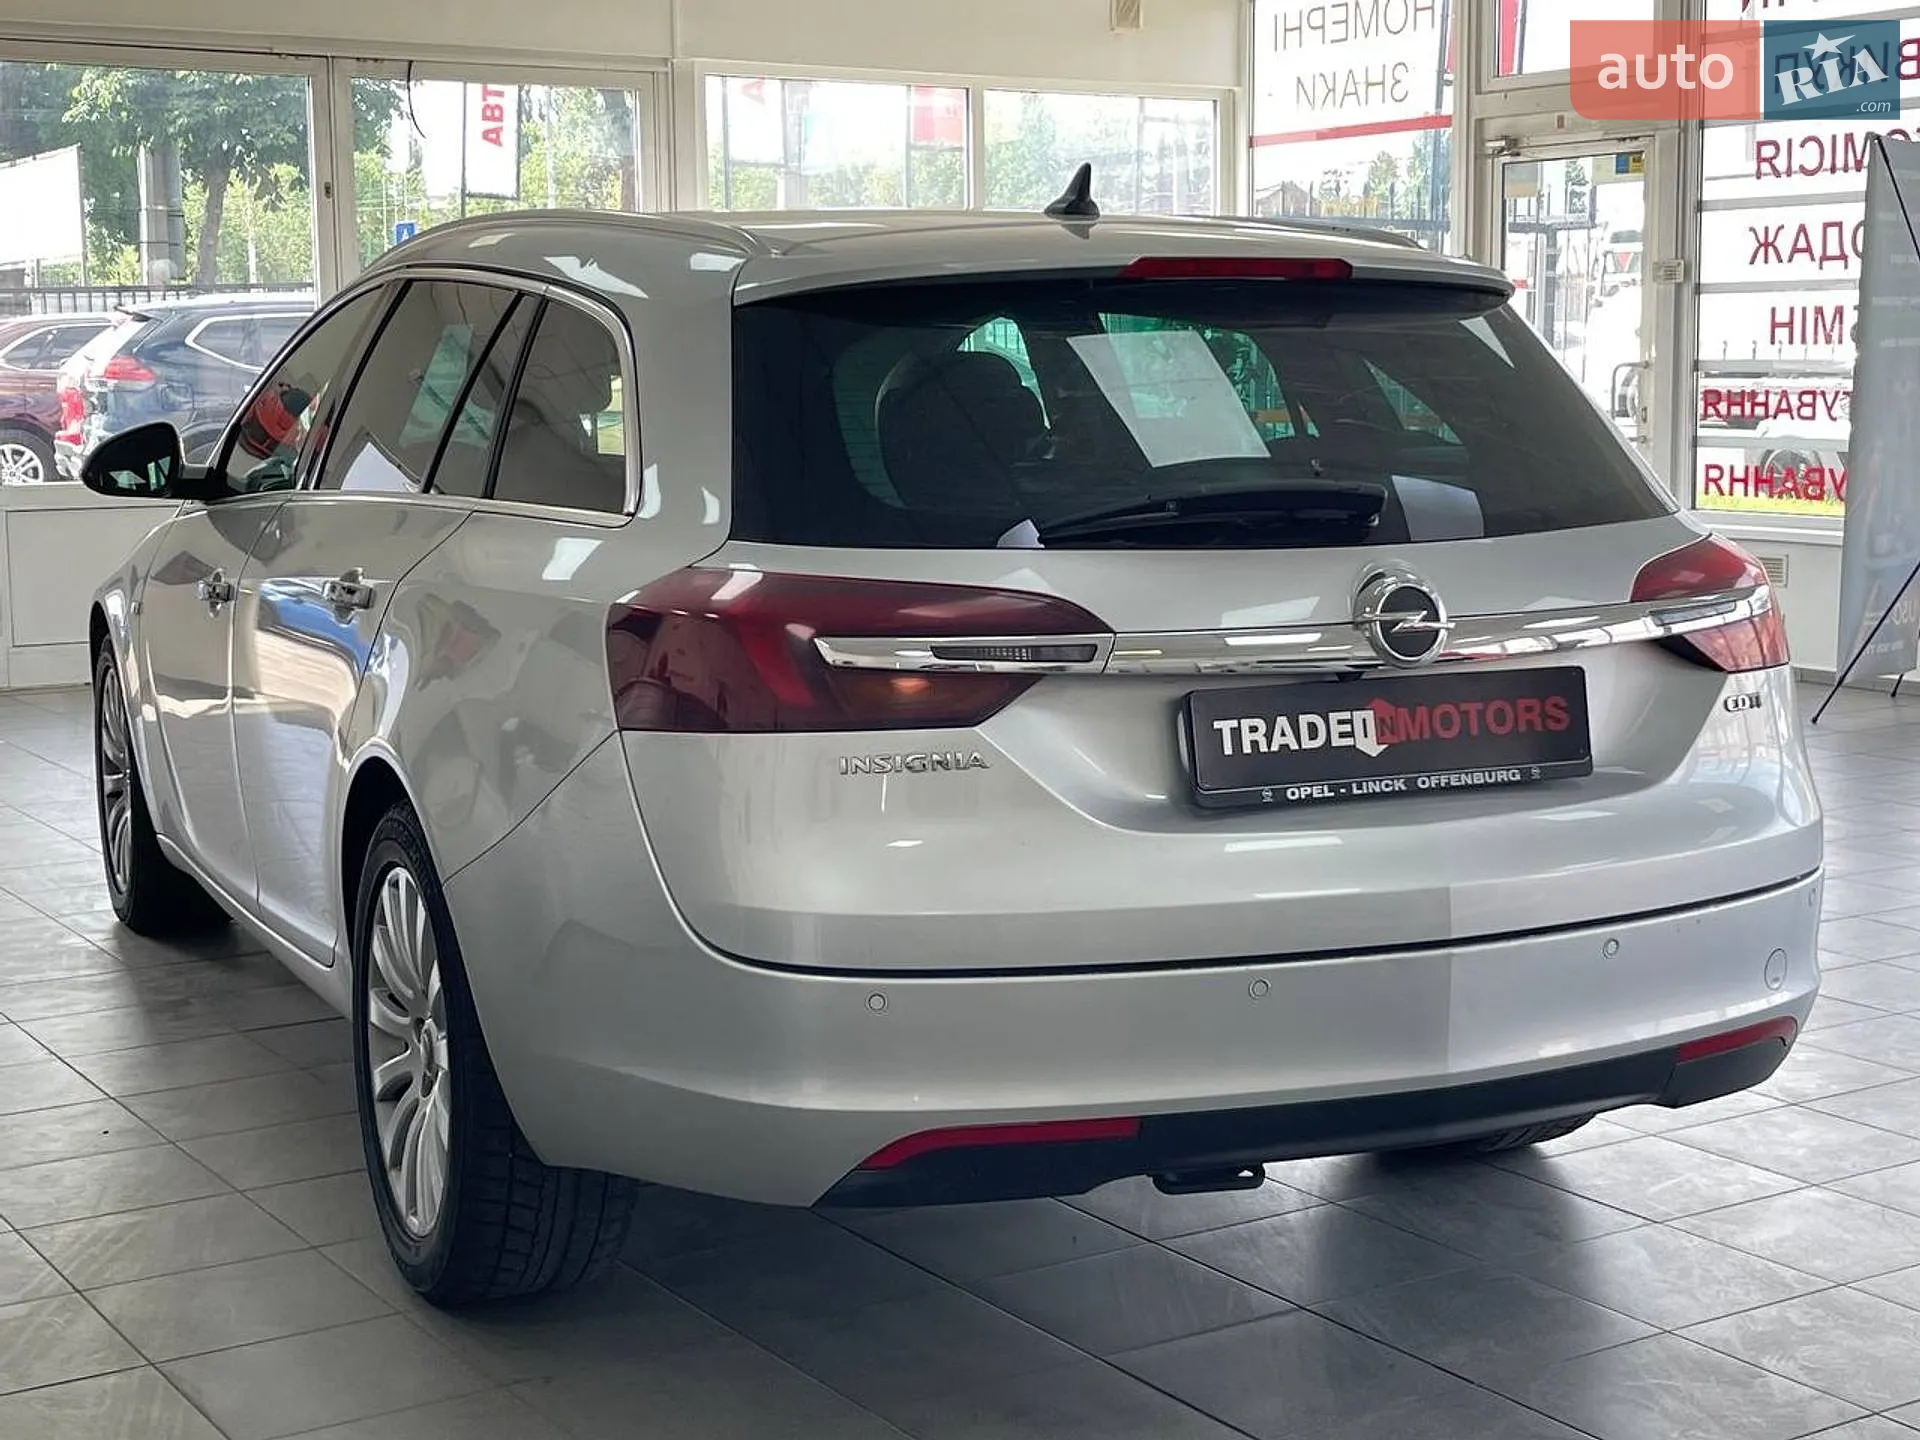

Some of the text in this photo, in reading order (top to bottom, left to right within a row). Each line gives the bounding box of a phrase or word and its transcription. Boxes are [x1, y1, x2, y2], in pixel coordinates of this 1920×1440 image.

[1397, 695, 1571, 741] MOTORS
[838, 751, 991, 776] INSIGNIA
[1286, 785, 1335, 801] OPEL
[1352, 778, 1408, 795] LINCK
[1417, 768, 1522, 790] OFFENBURG
